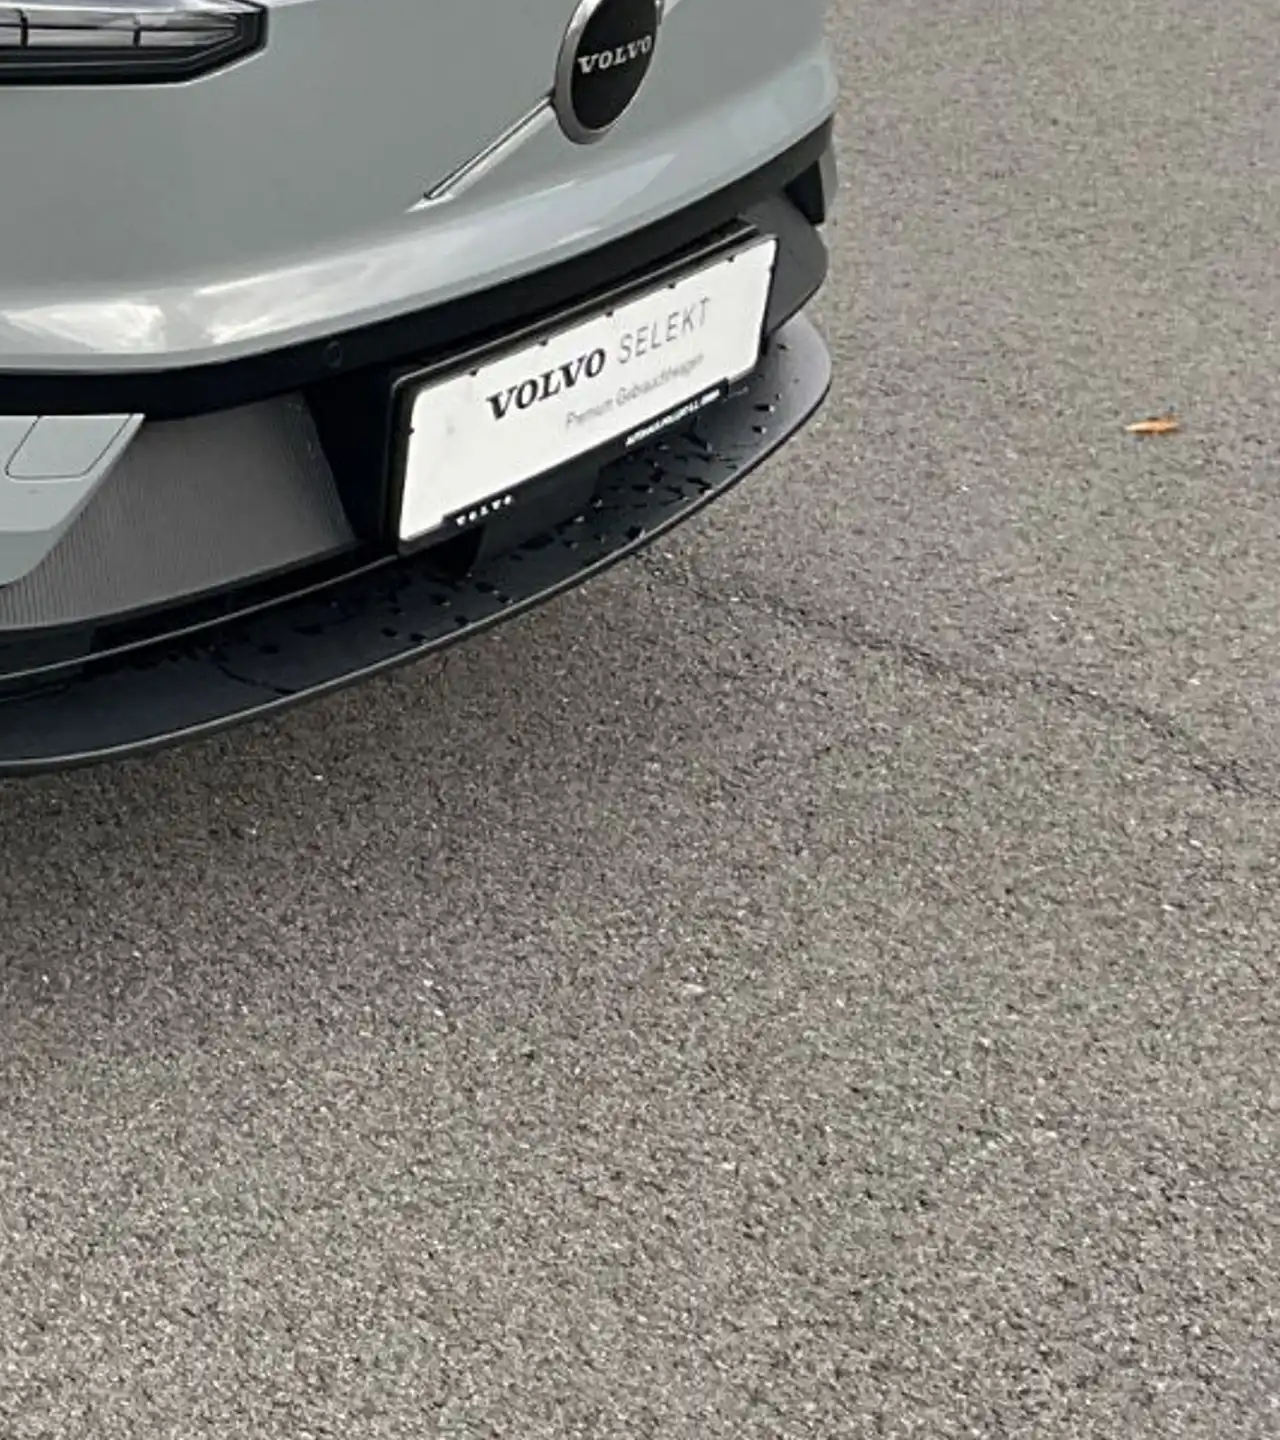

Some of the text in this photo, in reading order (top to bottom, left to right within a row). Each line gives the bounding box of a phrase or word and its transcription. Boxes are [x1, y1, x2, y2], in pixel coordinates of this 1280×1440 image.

[577, 35, 653, 75] VOLVO
[486, 347, 606, 421] VOLVO
[618, 297, 710, 365] SELEKT
